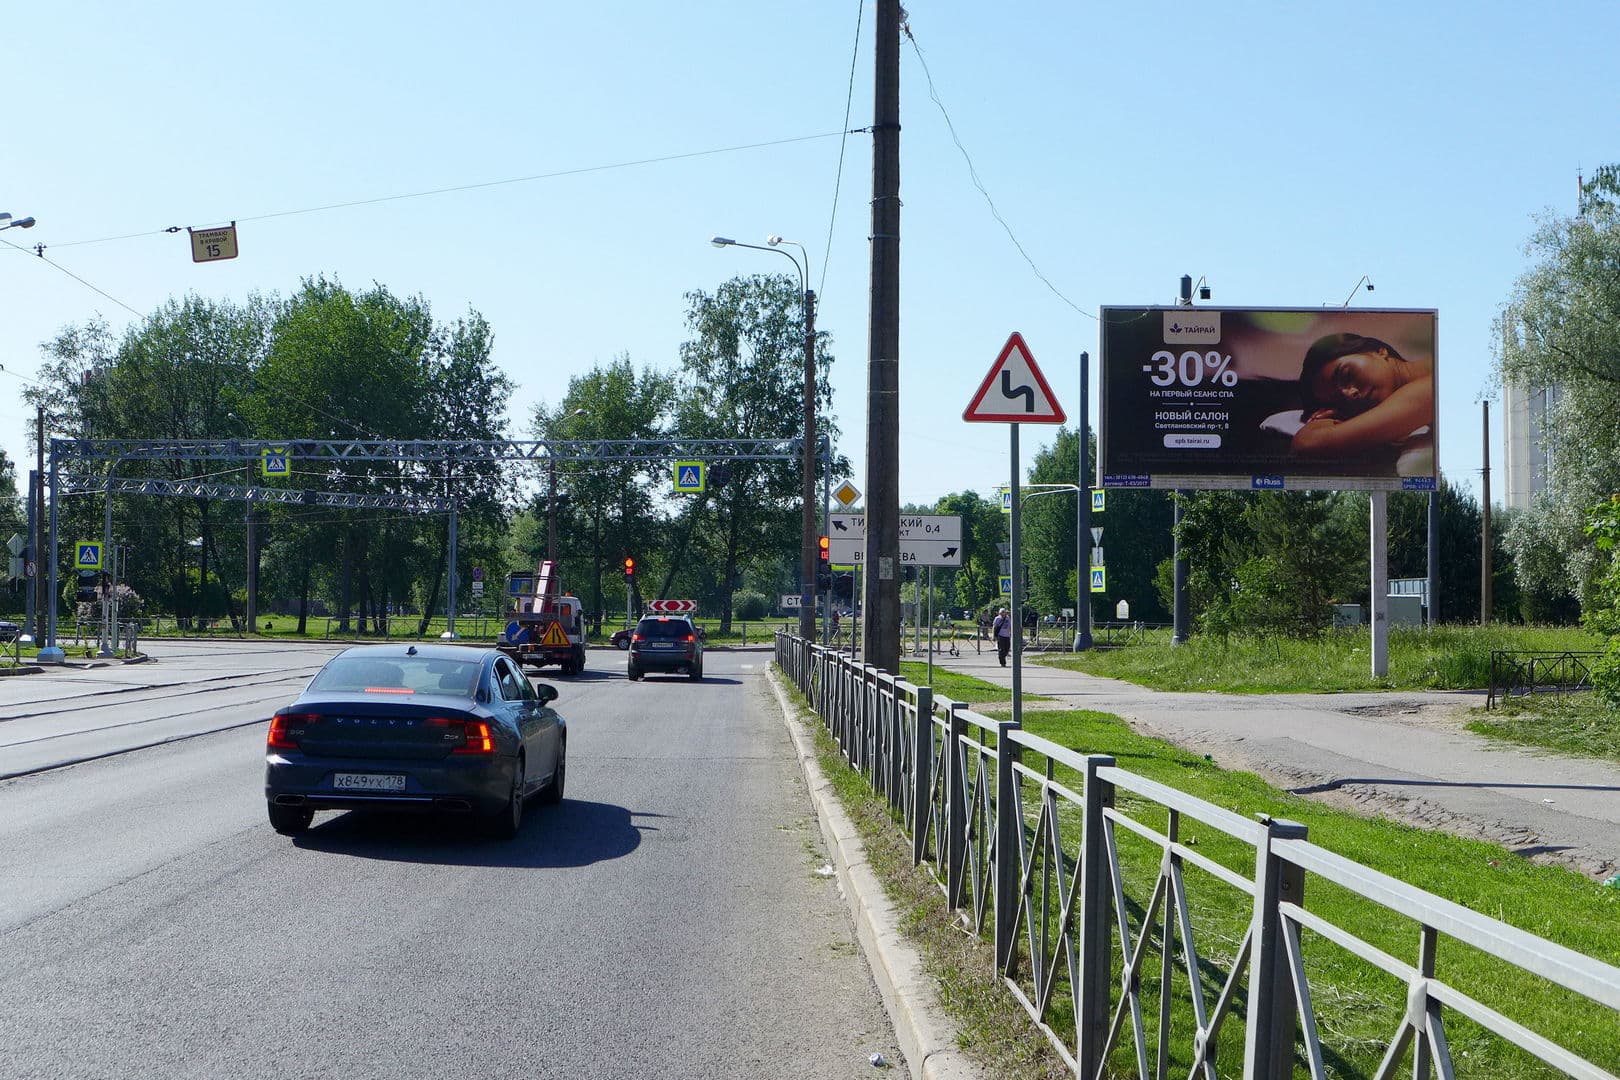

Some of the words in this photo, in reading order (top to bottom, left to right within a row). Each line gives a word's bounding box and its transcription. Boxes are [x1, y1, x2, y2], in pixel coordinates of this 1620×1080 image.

[206, 244, 221, 257] 15
[1184, 325, 1216, 334] ТАЙРАЙ
[1142, 350, 1238, 387] -30%
[1161, 390, 1192, 398] ПЕРВЫЙ
[1155, 410, 1192, 420] НОВЫЙ
[1193, 412, 1229, 420] САЛОН
[925, 525, 940, 534] 0,4
[385, 776, 403, 785] 178
